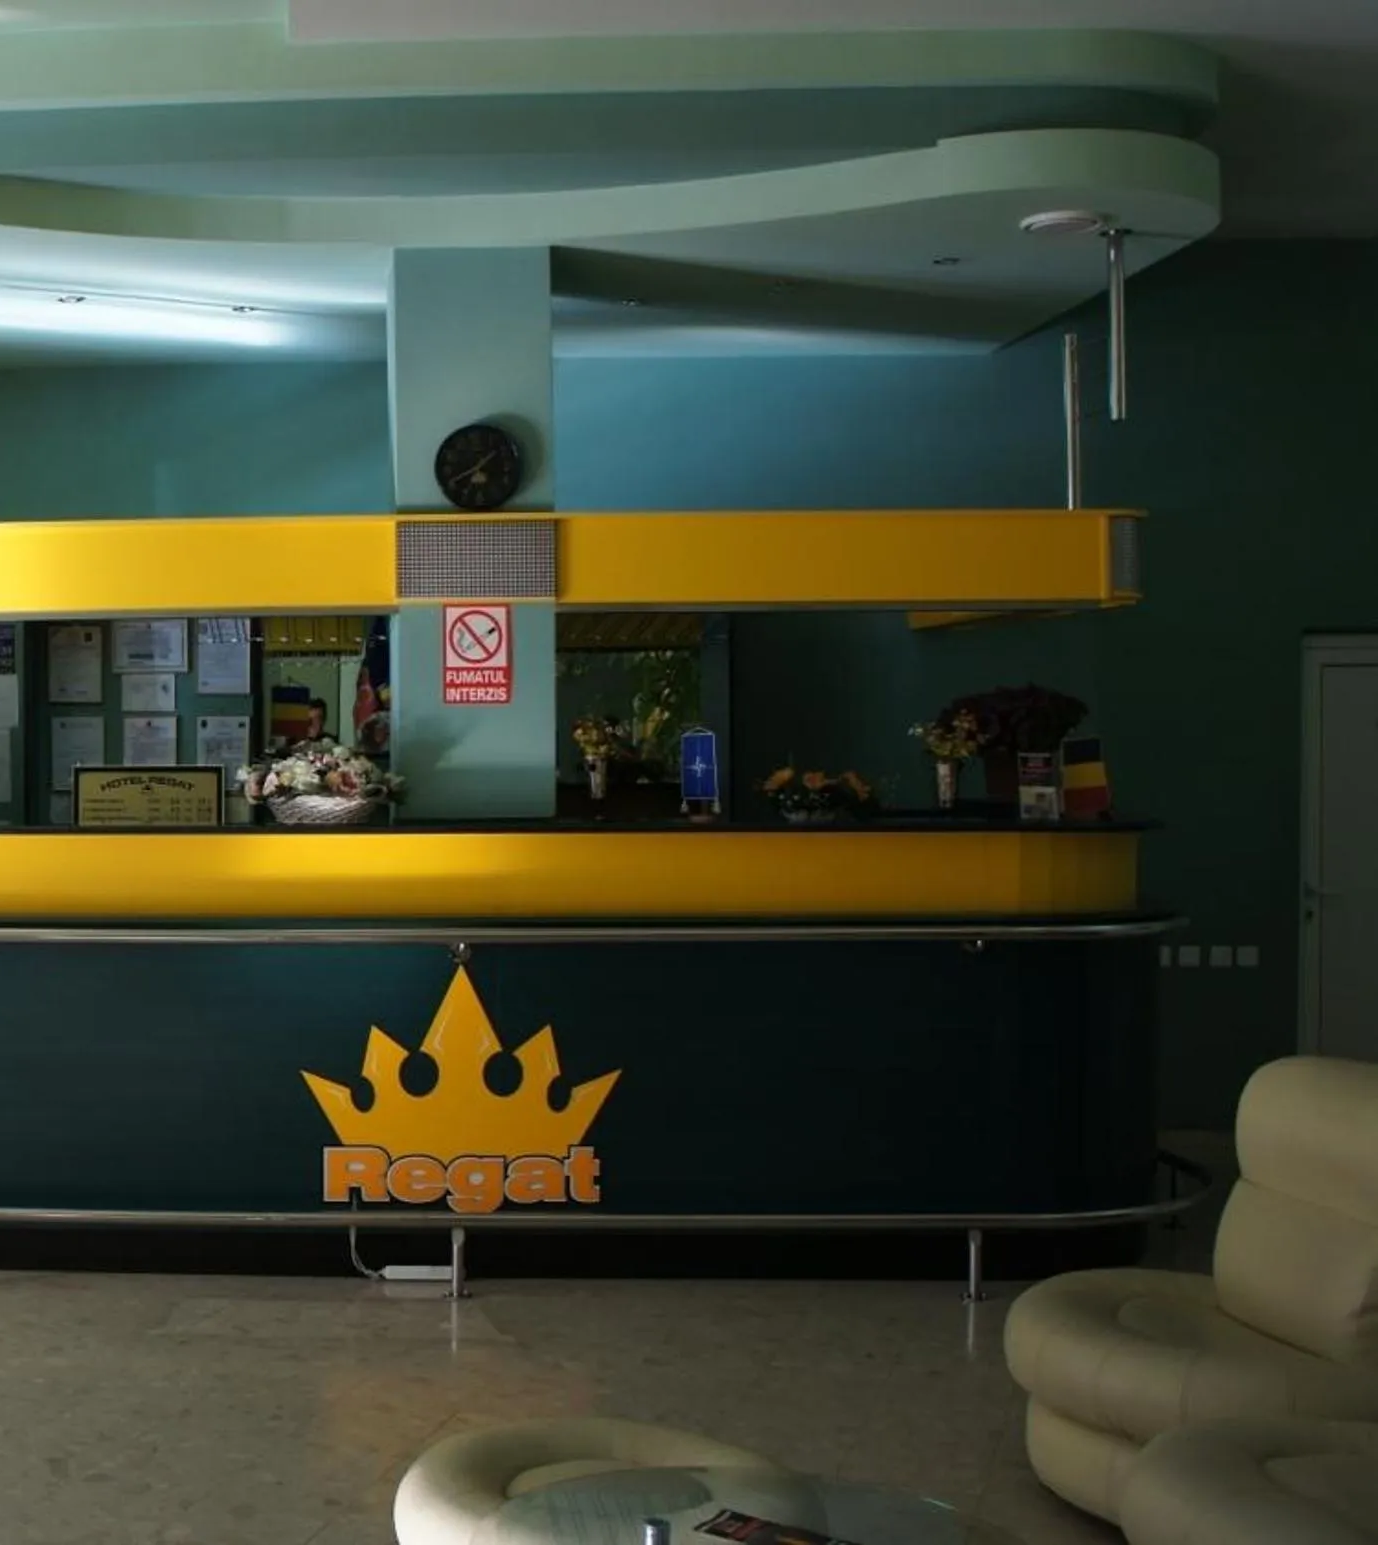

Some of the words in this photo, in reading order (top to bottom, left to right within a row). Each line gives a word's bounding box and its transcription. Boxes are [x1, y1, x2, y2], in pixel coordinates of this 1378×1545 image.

[446, 670, 507, 684] FUMATUL
[446, 687, 507, 701] INTERZIS
[100, 776, 146, 792] HOTEL
[323, 1146, 600, 1214] Regat
